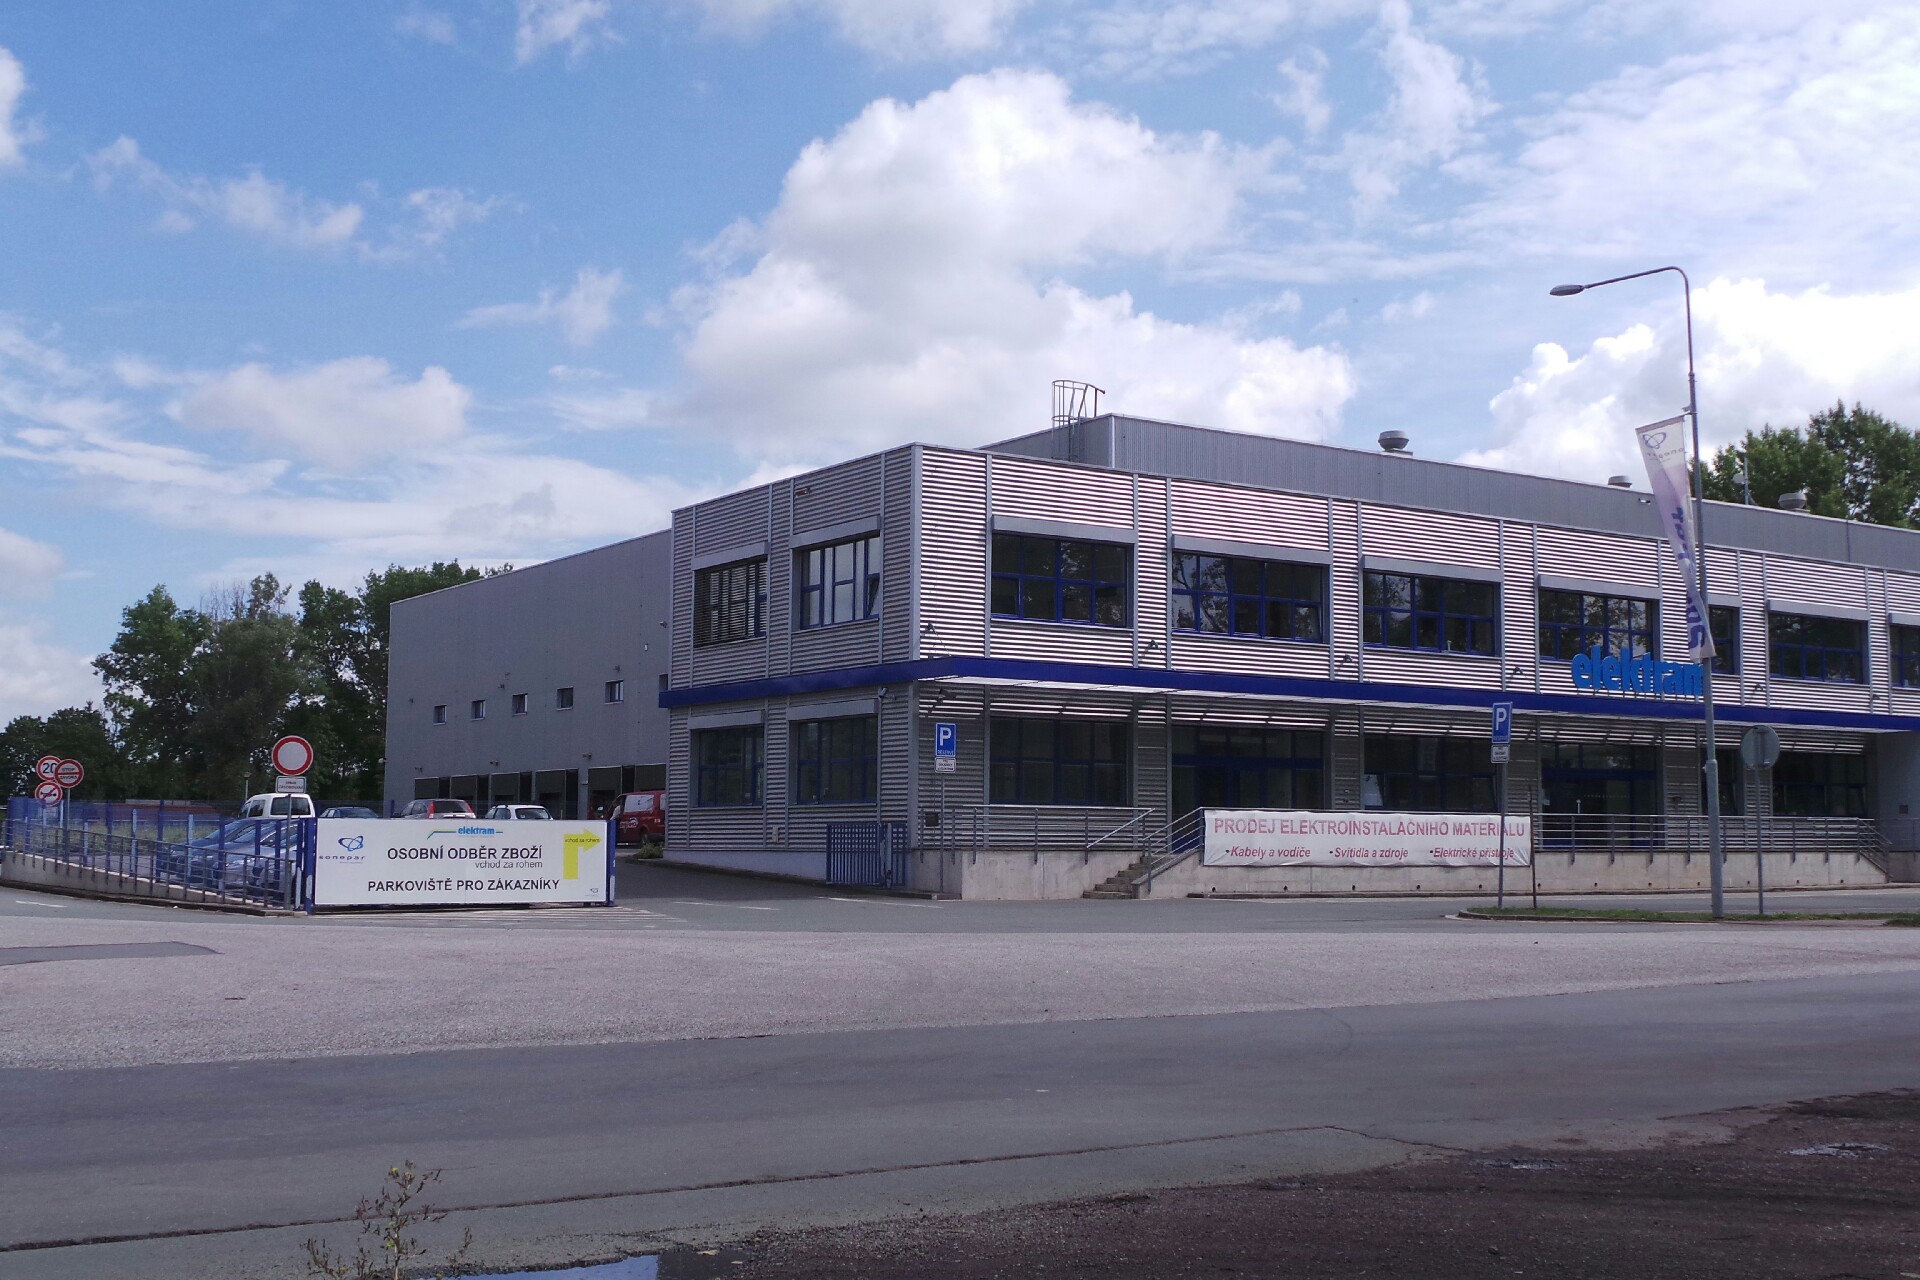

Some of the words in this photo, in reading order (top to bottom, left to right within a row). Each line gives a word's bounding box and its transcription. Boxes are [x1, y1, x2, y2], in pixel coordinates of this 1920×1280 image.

[1571, 645, 1704, 695] elektram
[1496, 708, 1507, 730] P
[940, 727, 951, 746] P
[43, 763, 57, 773] 20
[458, 826, 495, 835] elektram
[1214, 818, 1275, 834] PRODEJ
[387, 845, 444, 860] OSOBNÍ
[447, 845, 497, 860] ODBĚR
[501, 845, 542, 859] ZBOŽÍ
[1230, 846, 1266, 860] Kabely
[1268, 849, 1274, 857] a
[1277, 847, 1311, 858] vodiče
[1371, 849, 1377, 858] a
[1380, 847, 1409, 860] zdroje
[475, 860, 501, 869] vchod
[503, 861, 514, 869] za
[516, 860, 543, 869] rohem
[368, 877, 452, 892] PARKOVIŠTĚ
[456, 880, 484, 891] PRO
[487, 877, 560, 891] ZÁKAZNÍKY
